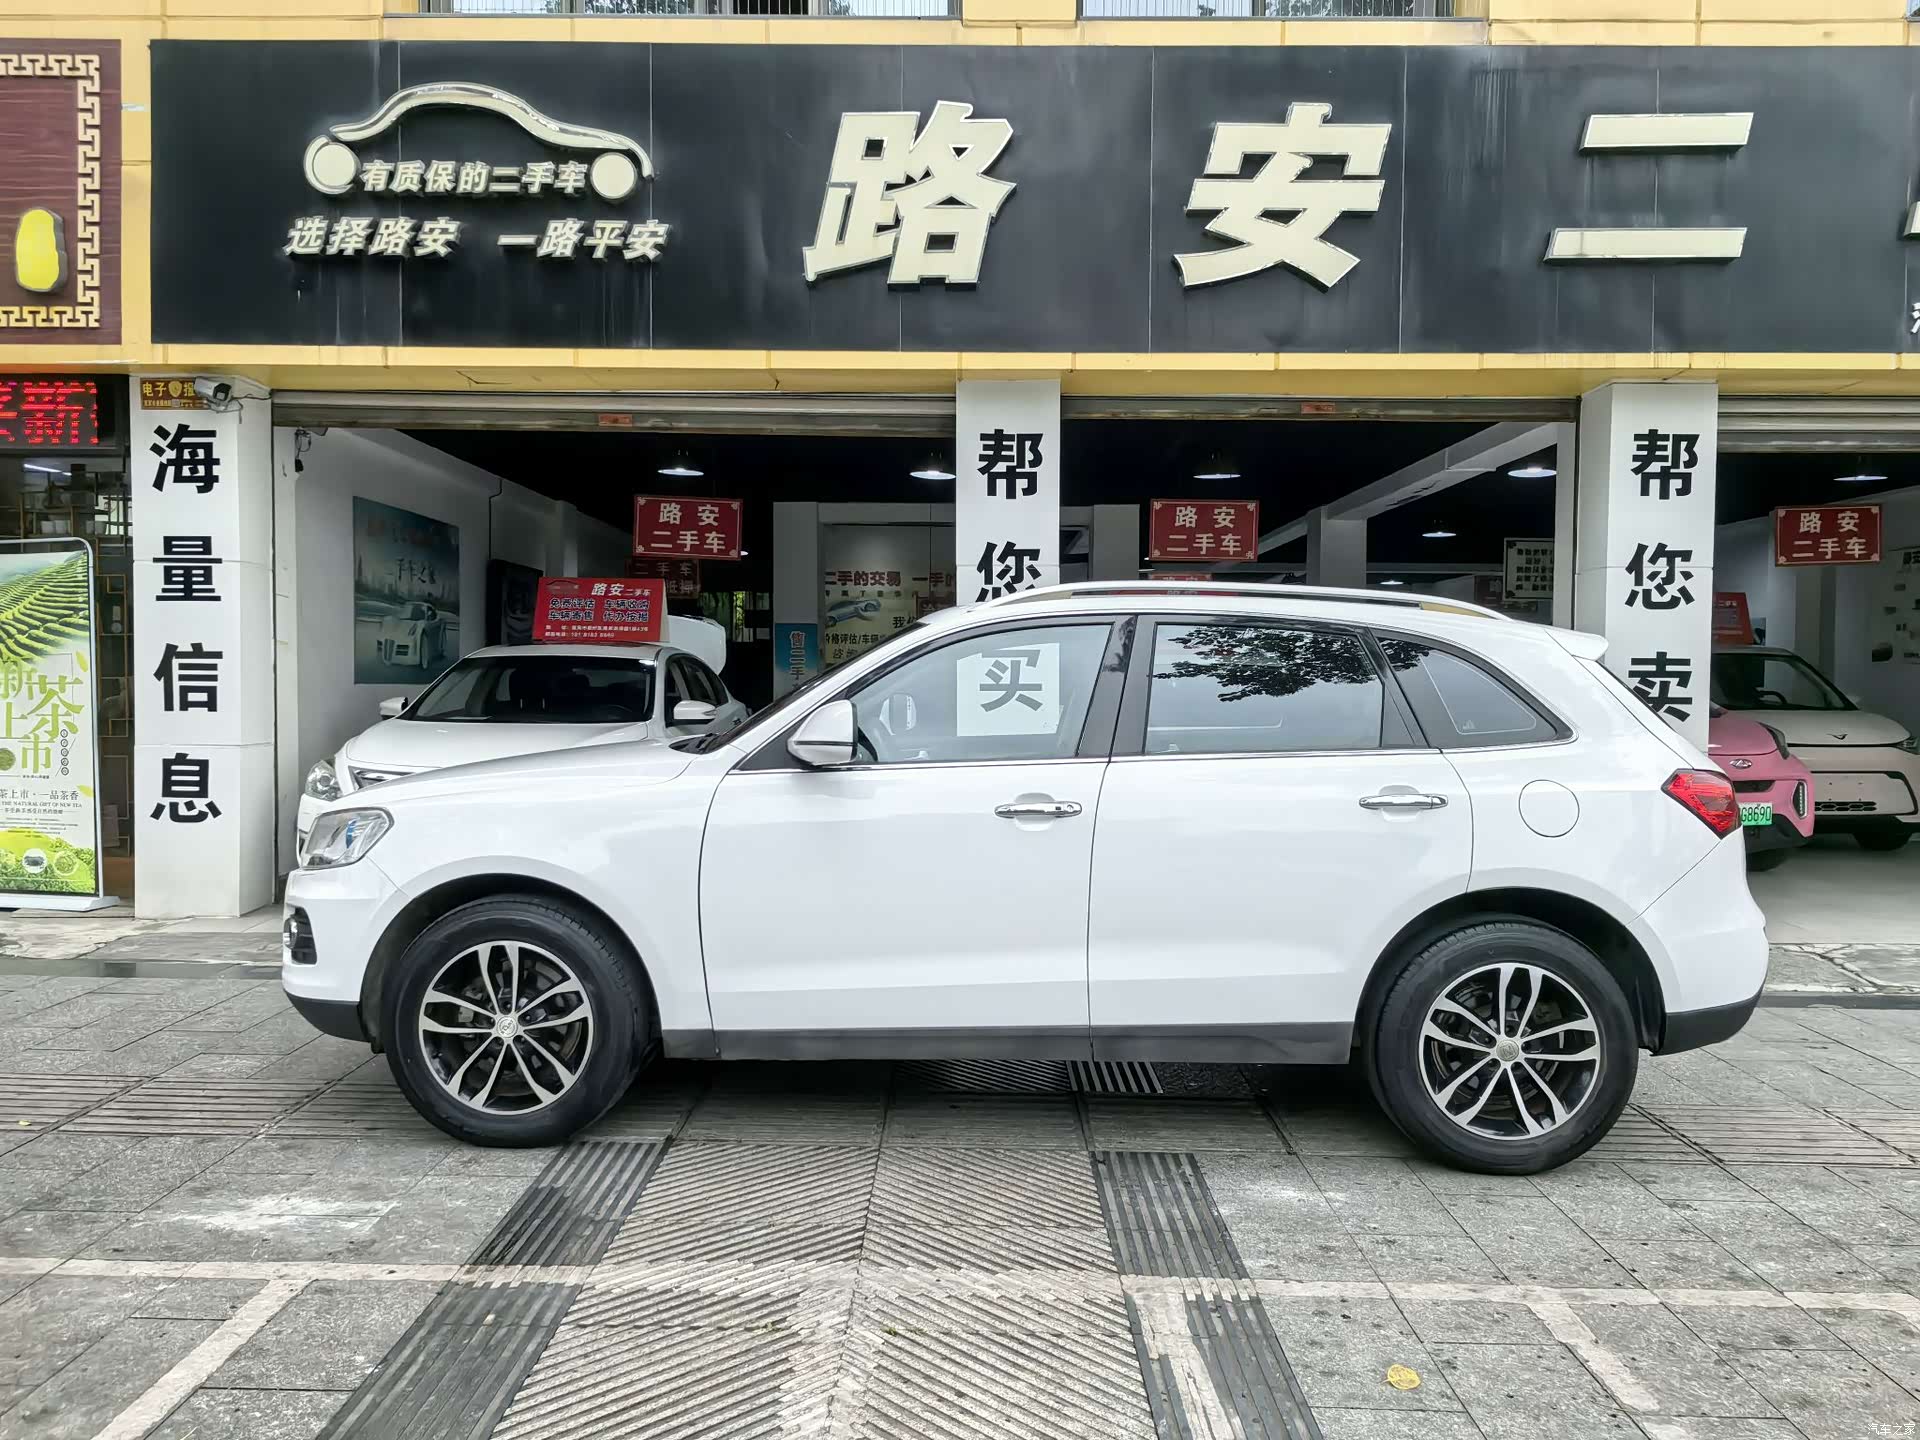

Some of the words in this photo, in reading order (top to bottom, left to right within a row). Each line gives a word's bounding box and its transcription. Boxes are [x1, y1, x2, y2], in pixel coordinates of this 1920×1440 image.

[360, 160, 590, 194] 有质保的二手车
[284, 216, 461, 257] 选择路安
[497, 218, 671, 261] 一路平安
[659, 502, 719, 526] 路安
[1174, 506, 1236, 529] 路安
[1799, 511, 1860, 533] 路安
[651, 530, 726, 553] 二手车
[1167, 533, 1242, 555] 二手车
[1792, 537, 1867, 560] 二手车
[149, 423, 223, 824] 海量信息
